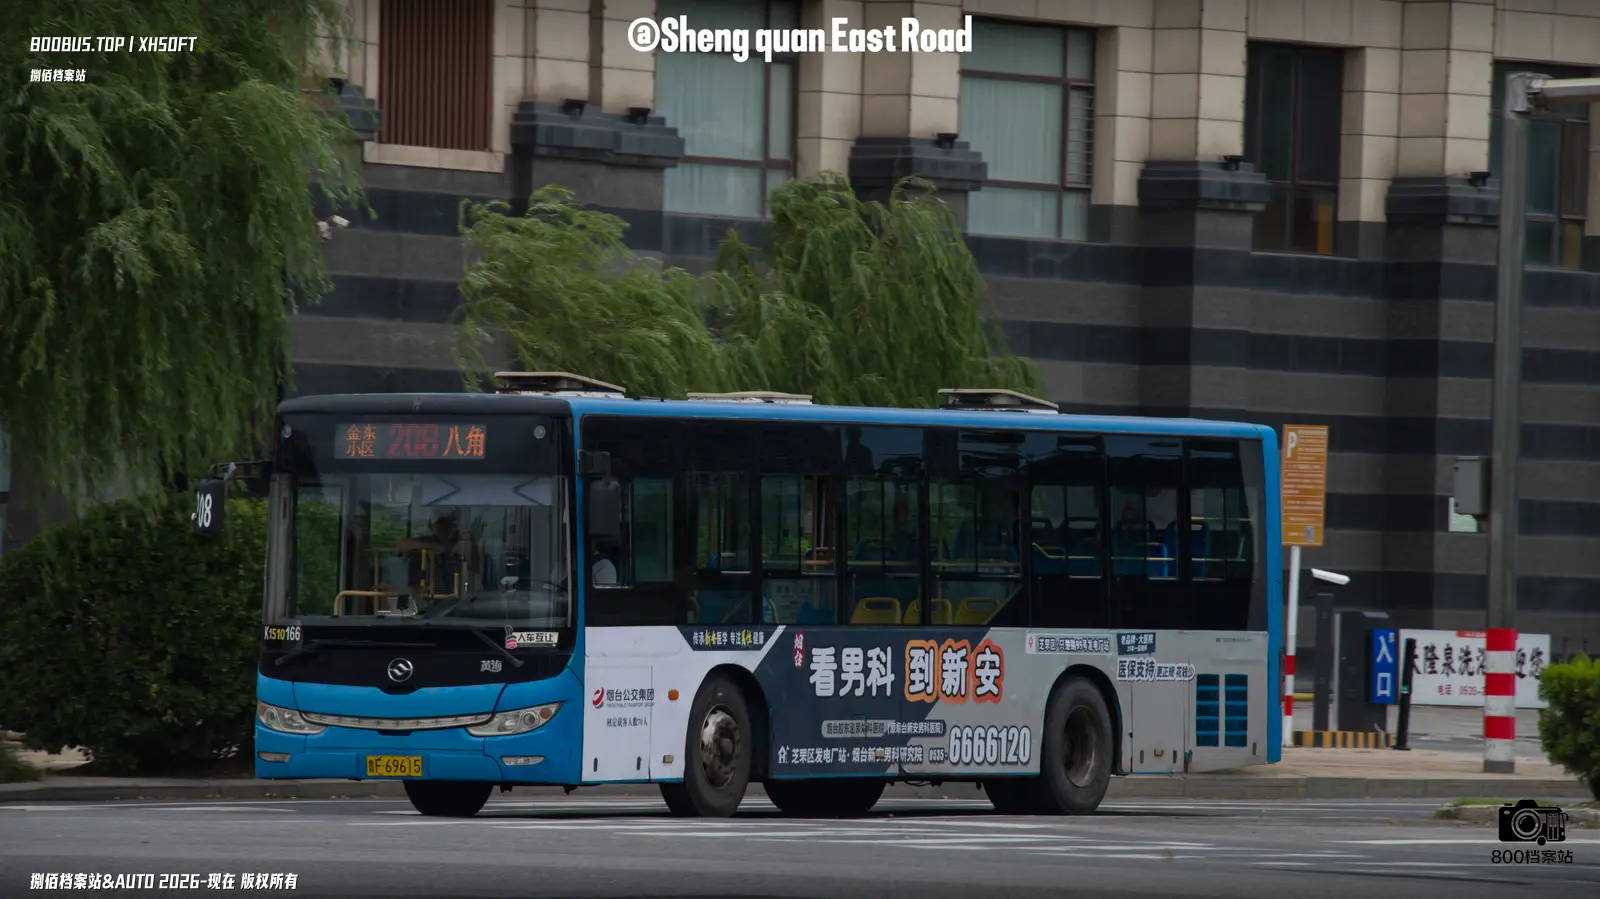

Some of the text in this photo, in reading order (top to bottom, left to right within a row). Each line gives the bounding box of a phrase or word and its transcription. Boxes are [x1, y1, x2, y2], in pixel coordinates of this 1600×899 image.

[346, 424, 377, 441] 金东
[388, 424, 439, 457] 208
[443, 425, 485, 457] 八角
[346, 441, 375, 457] 小区
[264, 625, 300, 641] K1510166
[518, 632, 554, 642] 人车互让
[794, 633, 804, 667] 烟台
[480, 659, 503, 673] 黄海
[809, 646, 1001, 697] 看男科 到新安
[1118, 660, 1155, 678] 医保支持
[1376, 636, 1393, 697] 入口
[606, 688, 655, 702] 烟台公交集团
[949, 726, 1032, 763] 6666120
